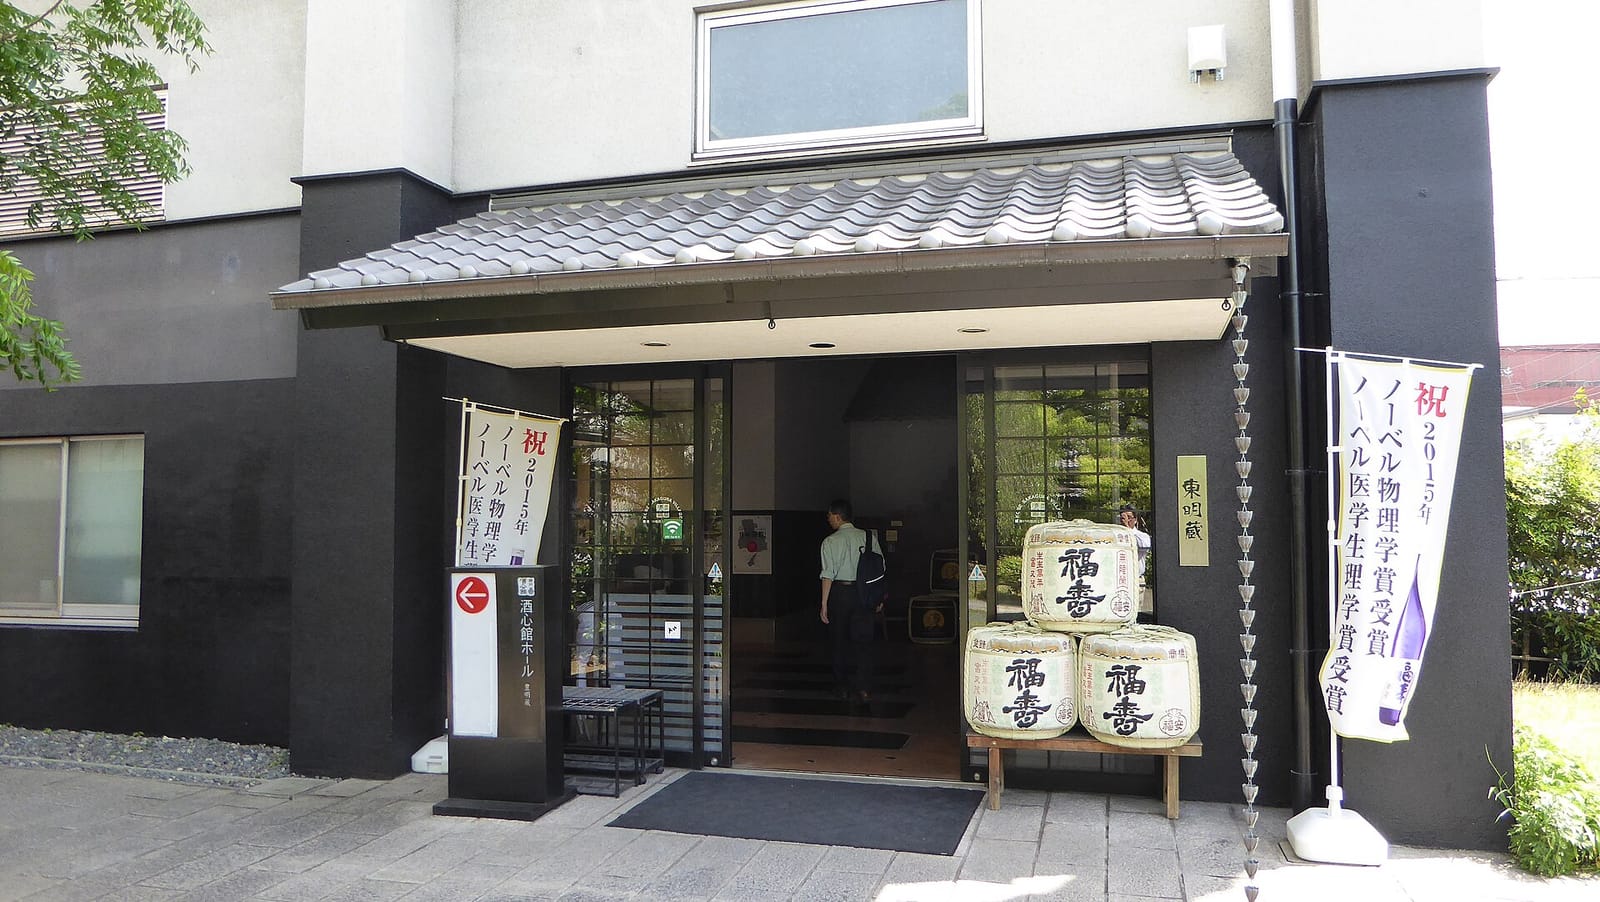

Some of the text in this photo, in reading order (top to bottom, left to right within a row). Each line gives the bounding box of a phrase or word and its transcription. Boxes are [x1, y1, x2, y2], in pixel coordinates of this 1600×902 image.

[1182, 478, 1203, 541] 東明蔵
[1365, 379, 1403, 659] ノーベル物理学賞受賞
[520, 599, 535, 678] 酒心館ホール
